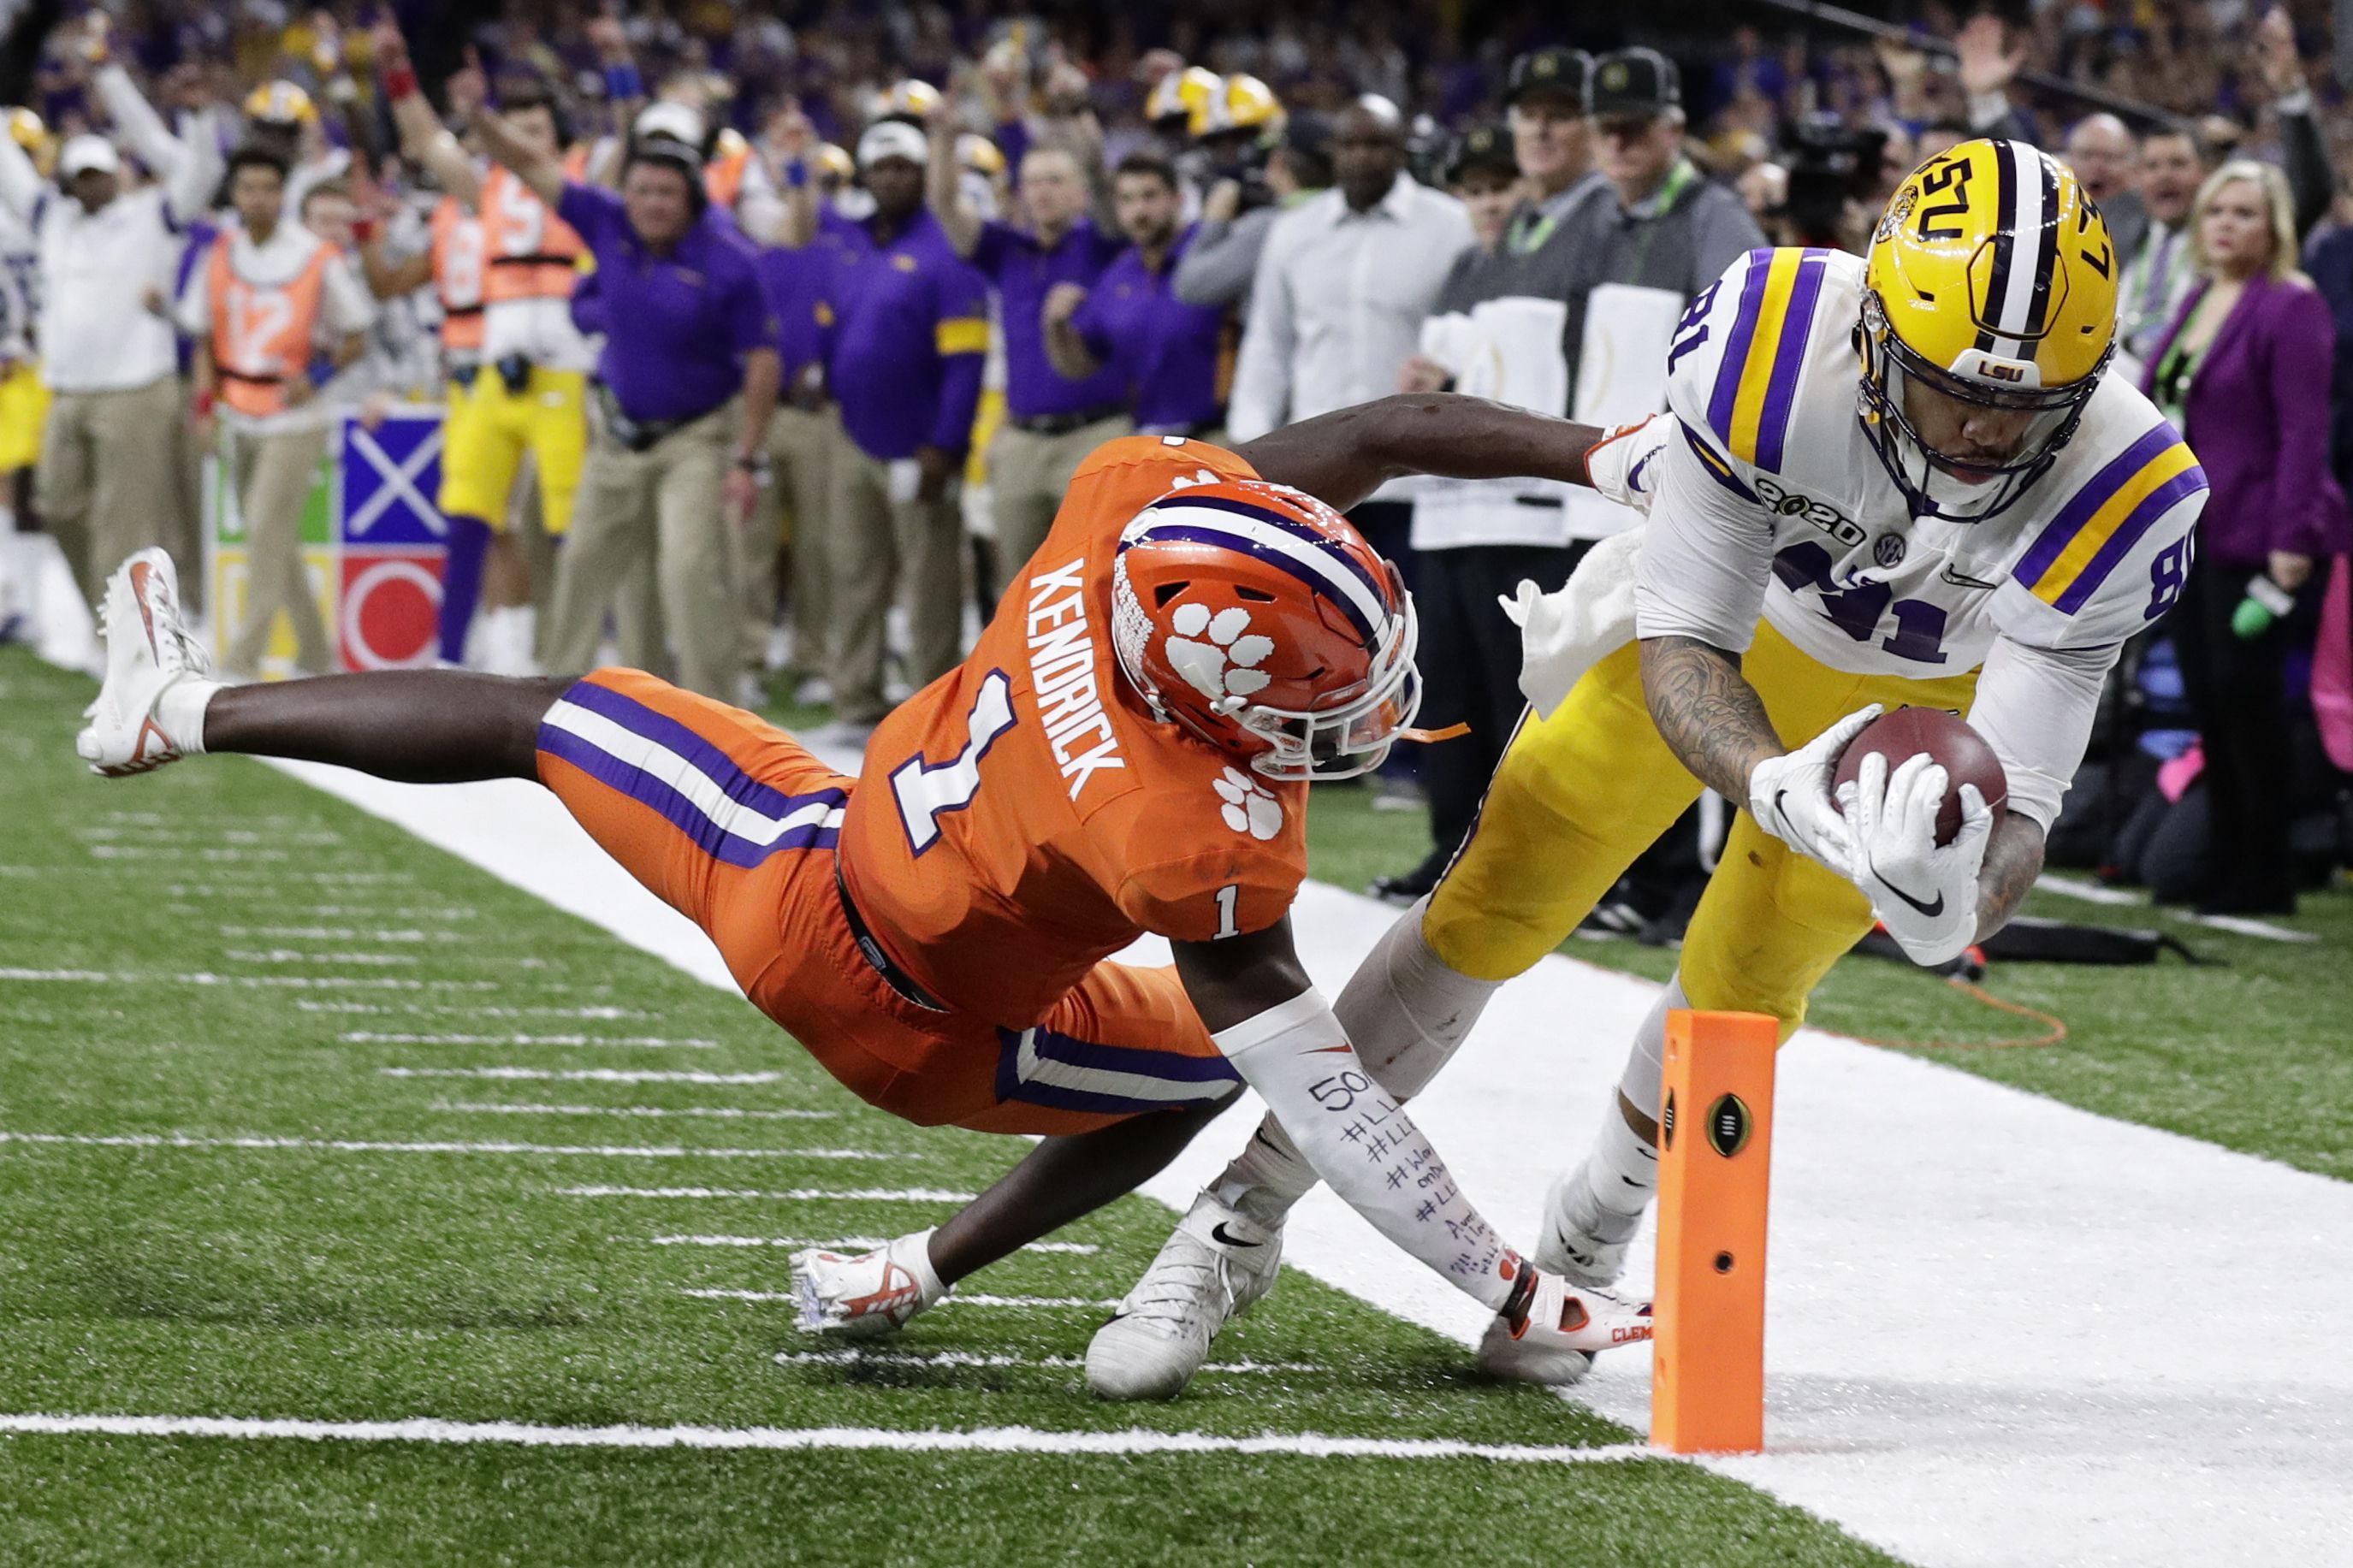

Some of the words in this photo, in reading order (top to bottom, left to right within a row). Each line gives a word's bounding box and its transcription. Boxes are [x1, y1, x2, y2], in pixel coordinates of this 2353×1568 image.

[499, 173, 543, 256] 5
[226, 287, 296, 376] 12
[1667, 278, 1723, 377] 81
[1977, 359, 2024, 382] LSU
[1755, 477, 1868, 547] 2020
[1026, 556, 1126, 802] KENDRICK
[887, 666, 1019, 860] 1
[1212, 884, 1240, 940] 1
